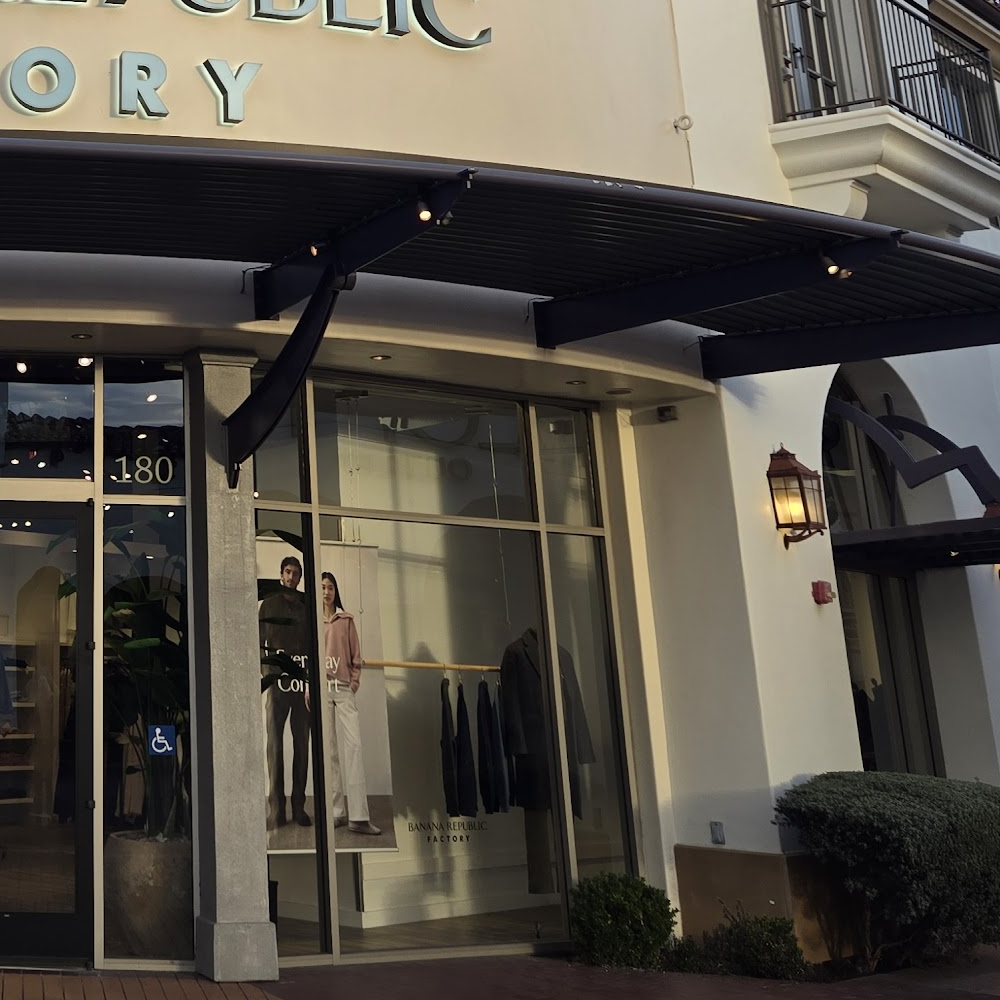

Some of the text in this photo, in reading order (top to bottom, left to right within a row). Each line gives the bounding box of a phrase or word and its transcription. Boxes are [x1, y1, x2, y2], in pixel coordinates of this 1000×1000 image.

[114, 456, 174, 484] 180
[408, 820, 488, 832] BANANA REPUBLIC
[427, 835, 470, 843] FACTORY
